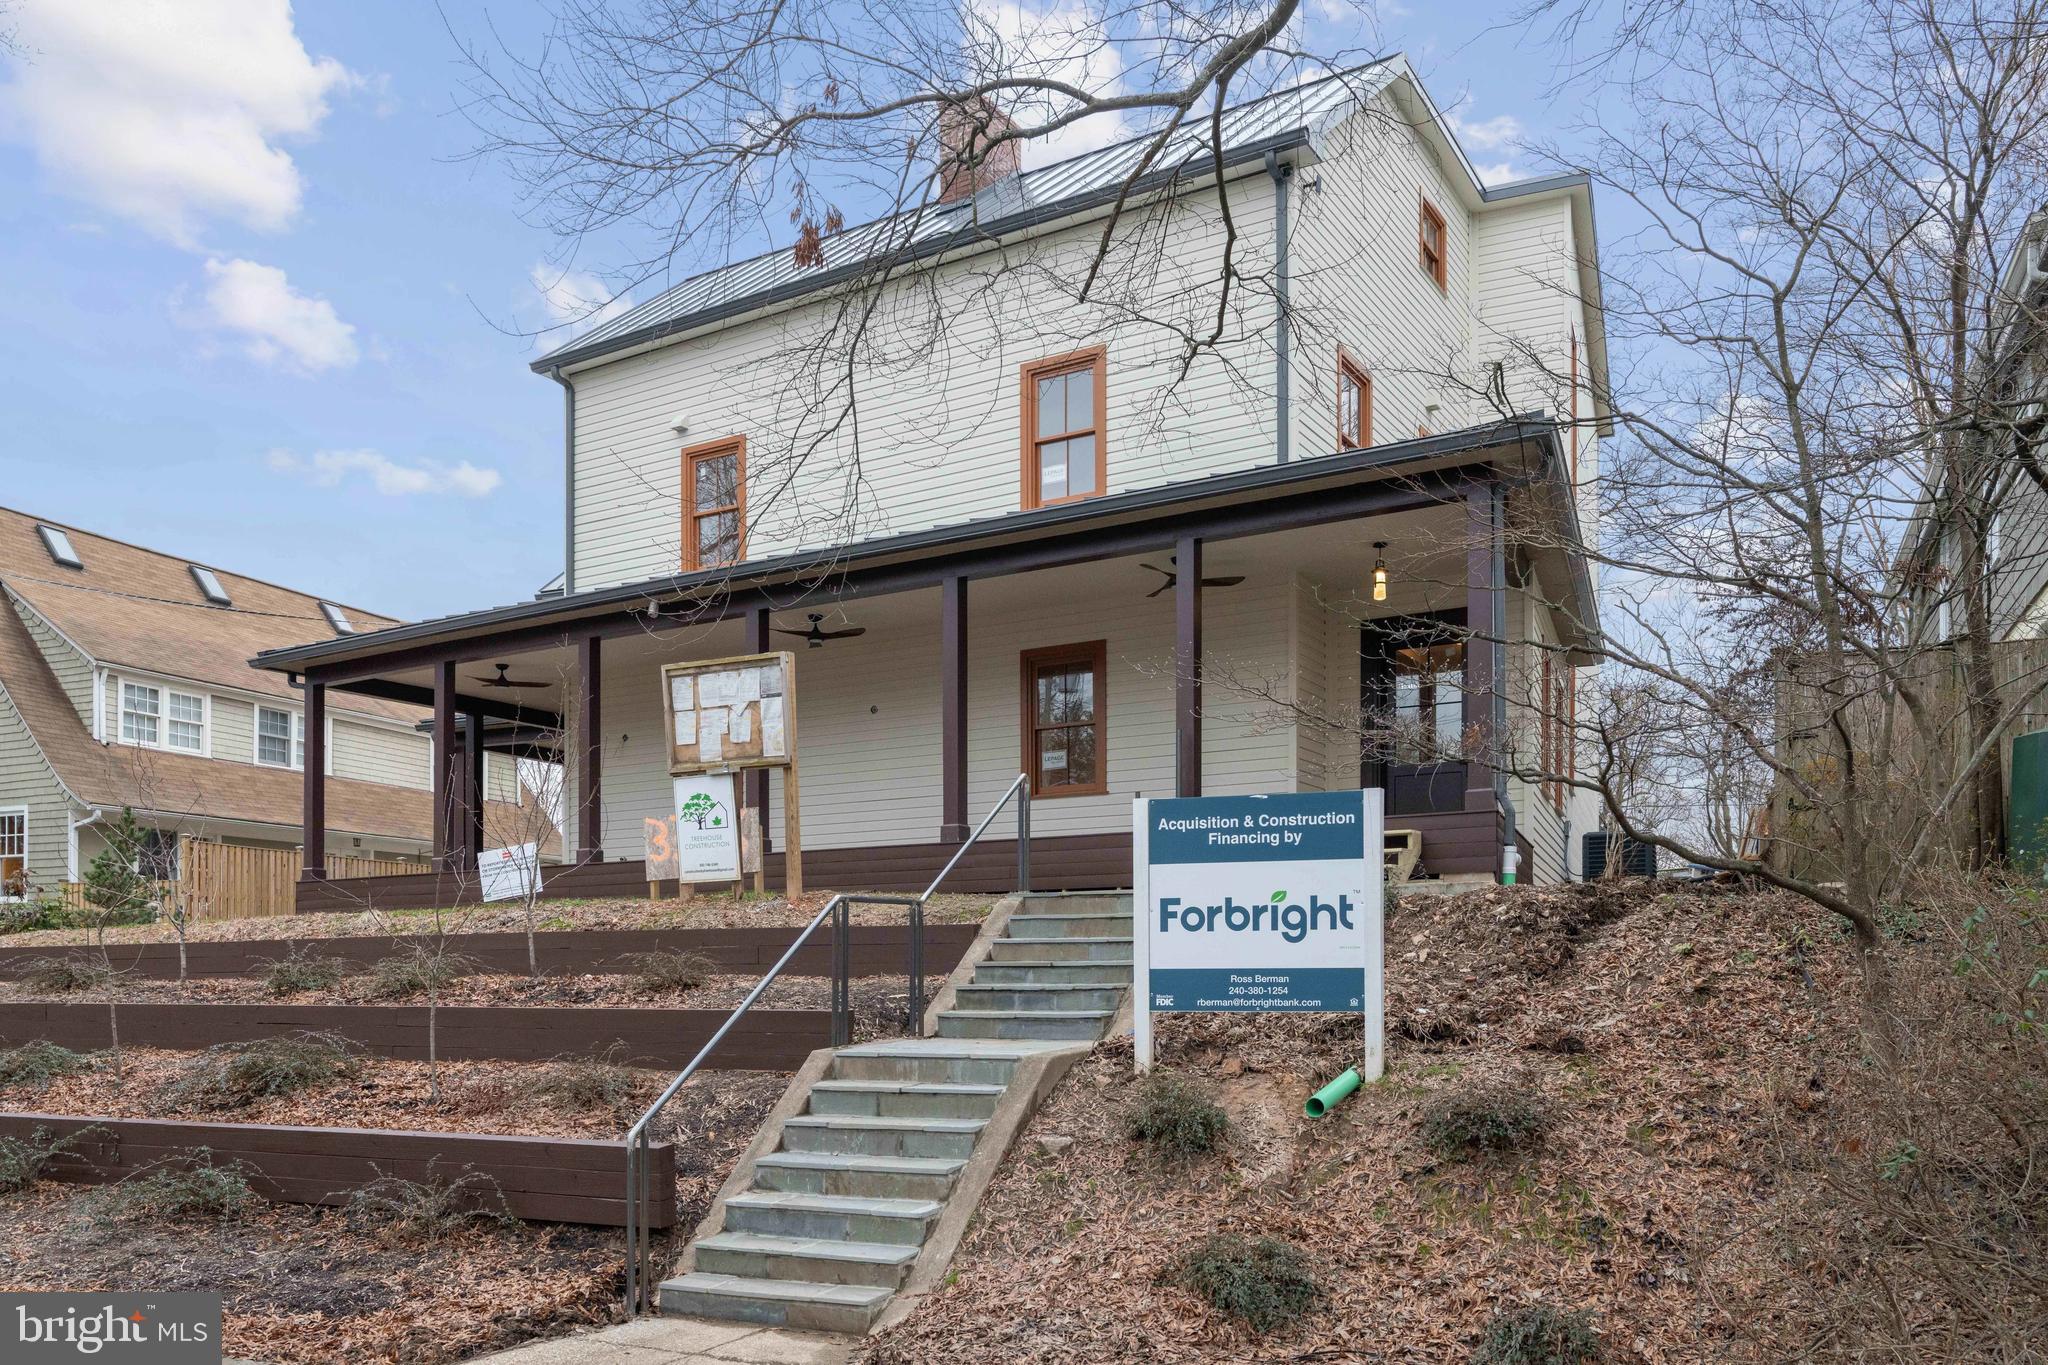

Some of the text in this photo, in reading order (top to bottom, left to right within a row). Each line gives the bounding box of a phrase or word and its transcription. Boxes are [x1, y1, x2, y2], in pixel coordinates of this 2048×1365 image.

[1158, 812, 1355, 832] Acquisition & Construction
[1208, 830, 1302, 846] Financing by
[684, 840, 730, 850] CONSTRUCTION
[1160, 890, 1353, 943] Forbright
[1230, 975, 1289, 983] Ross Berman
[1228, 986, 1289, 995] 240-380-1254
[1156, 998, 1174, 1006] FDIC
[1197, 998, 1321, 1008] rberman@forbrightbank.com
